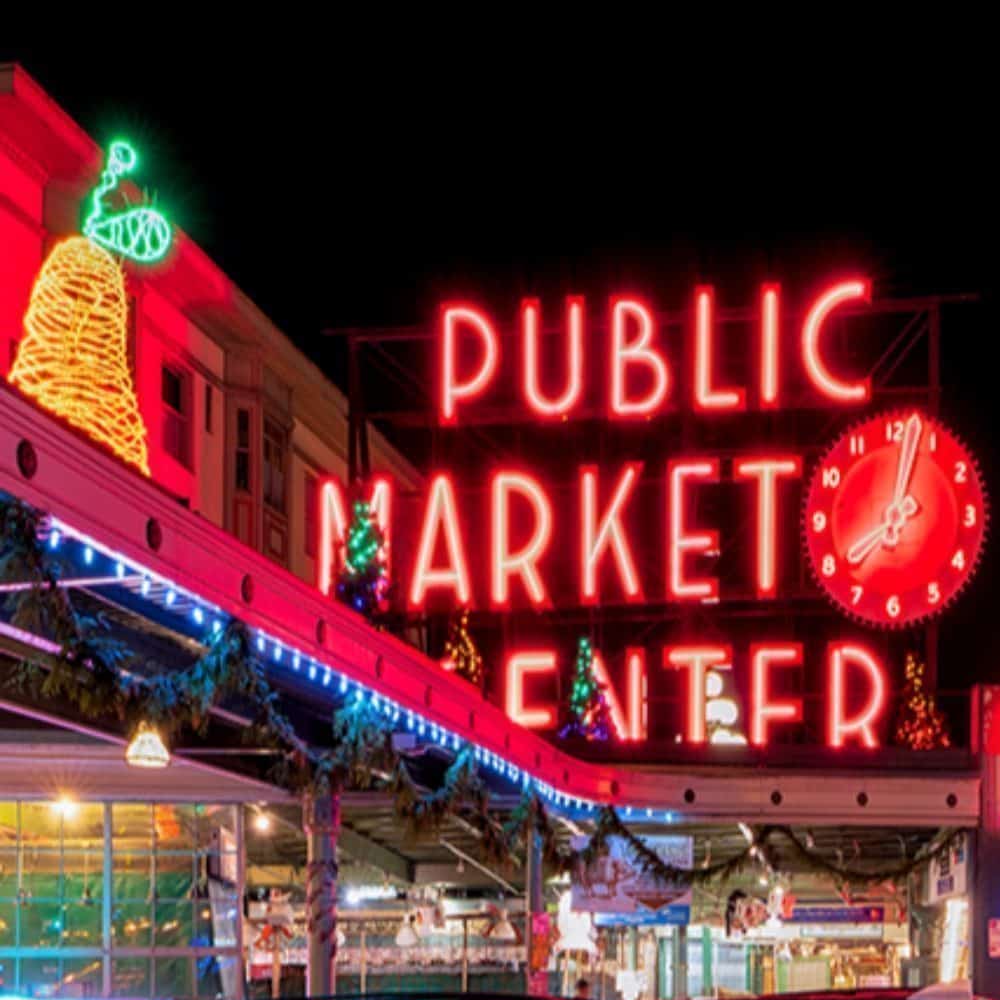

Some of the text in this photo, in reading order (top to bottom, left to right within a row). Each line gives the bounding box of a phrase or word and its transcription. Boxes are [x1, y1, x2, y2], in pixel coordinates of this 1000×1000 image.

[439, 281, 873, 424] PUBLIC
[886, 421, 904, 441] 12
[850, 436, 865, 455] 11
[822, 466, 841, 488] 10
[954, 462, 967, 483] 2
[812, 511, 826, 533] 9
[963, 504, 976, 527] 3
[318, 458, 799, 608] MARKET
[821, 554, 836, 577] 8
[951, 550, 965, 570] 4
[850, 586, 863, 605] 7
[886, 595, 900, 617] 6
[503, 643, 888, 749] ENTER
